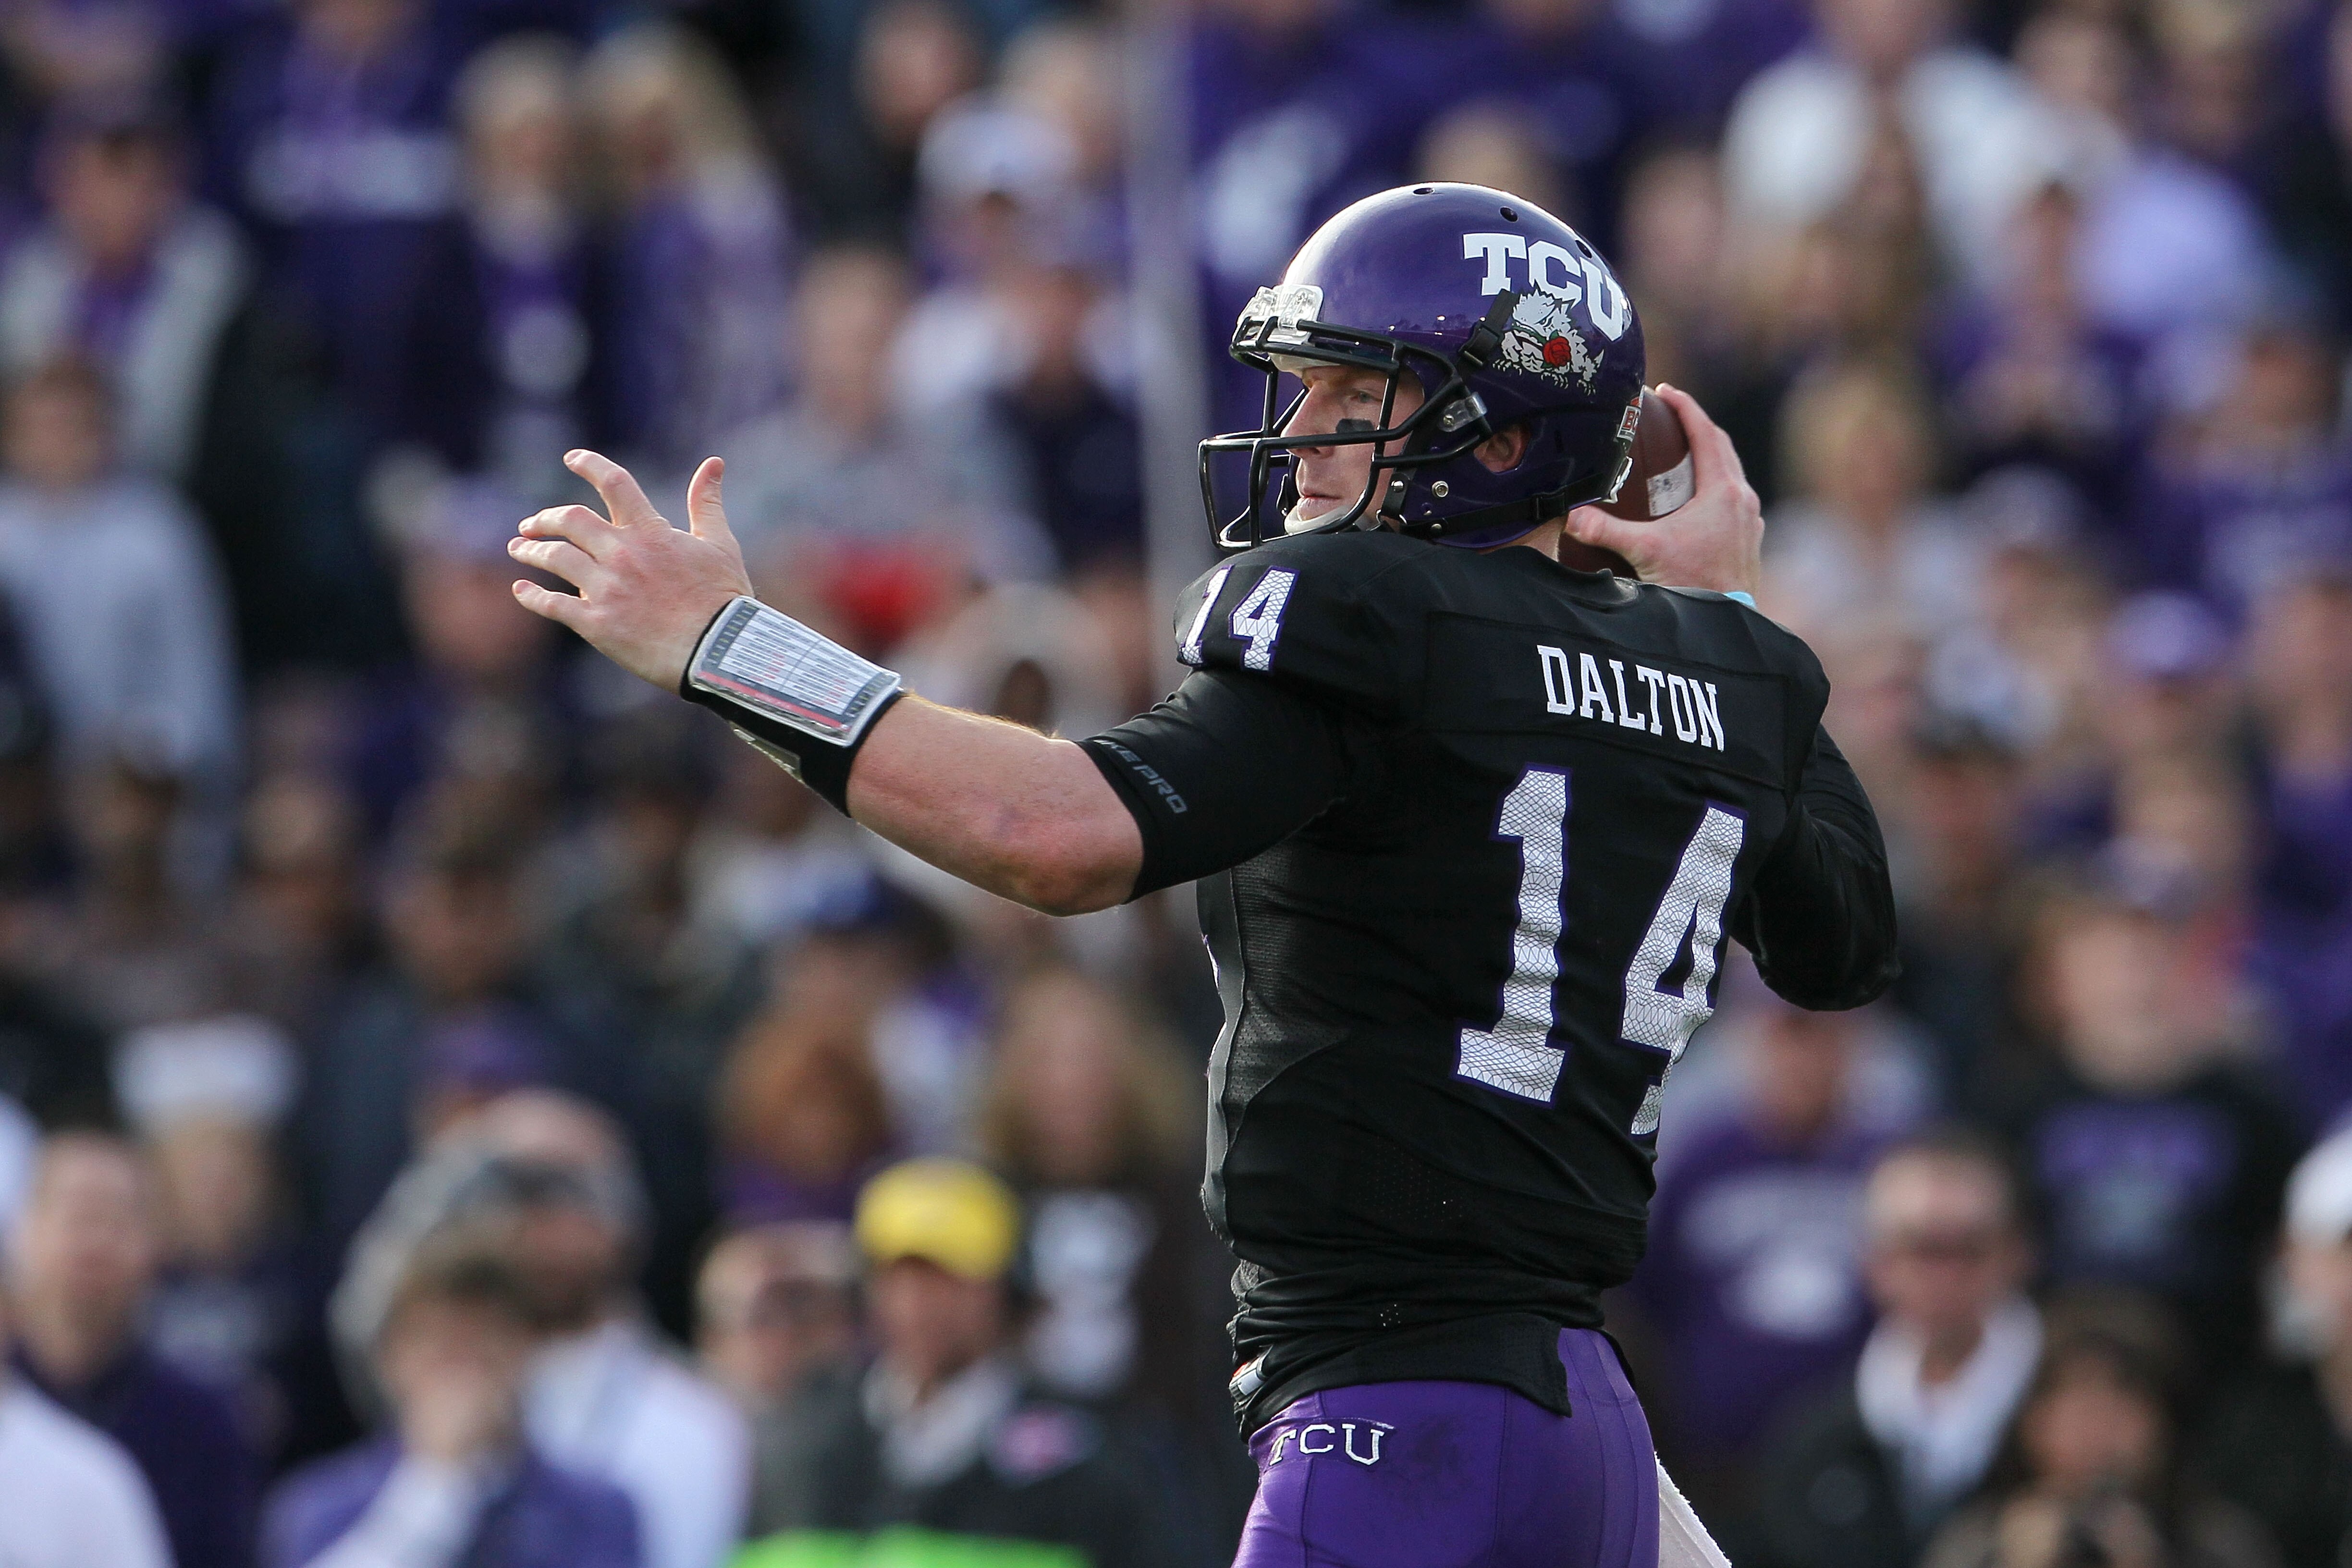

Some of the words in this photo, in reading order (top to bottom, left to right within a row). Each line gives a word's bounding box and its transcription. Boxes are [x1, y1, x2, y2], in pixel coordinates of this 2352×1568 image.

[1463, 233, 1623, 342] TCU
[1179, 564, 1298, 673] 14
[1537, 645, 1725, 752] DALTON
[1132, 764, 1188, 814] PRO
[1452, 763, 1748, 1136] 14
[1269, 1423, 1385, 1466] TCU
